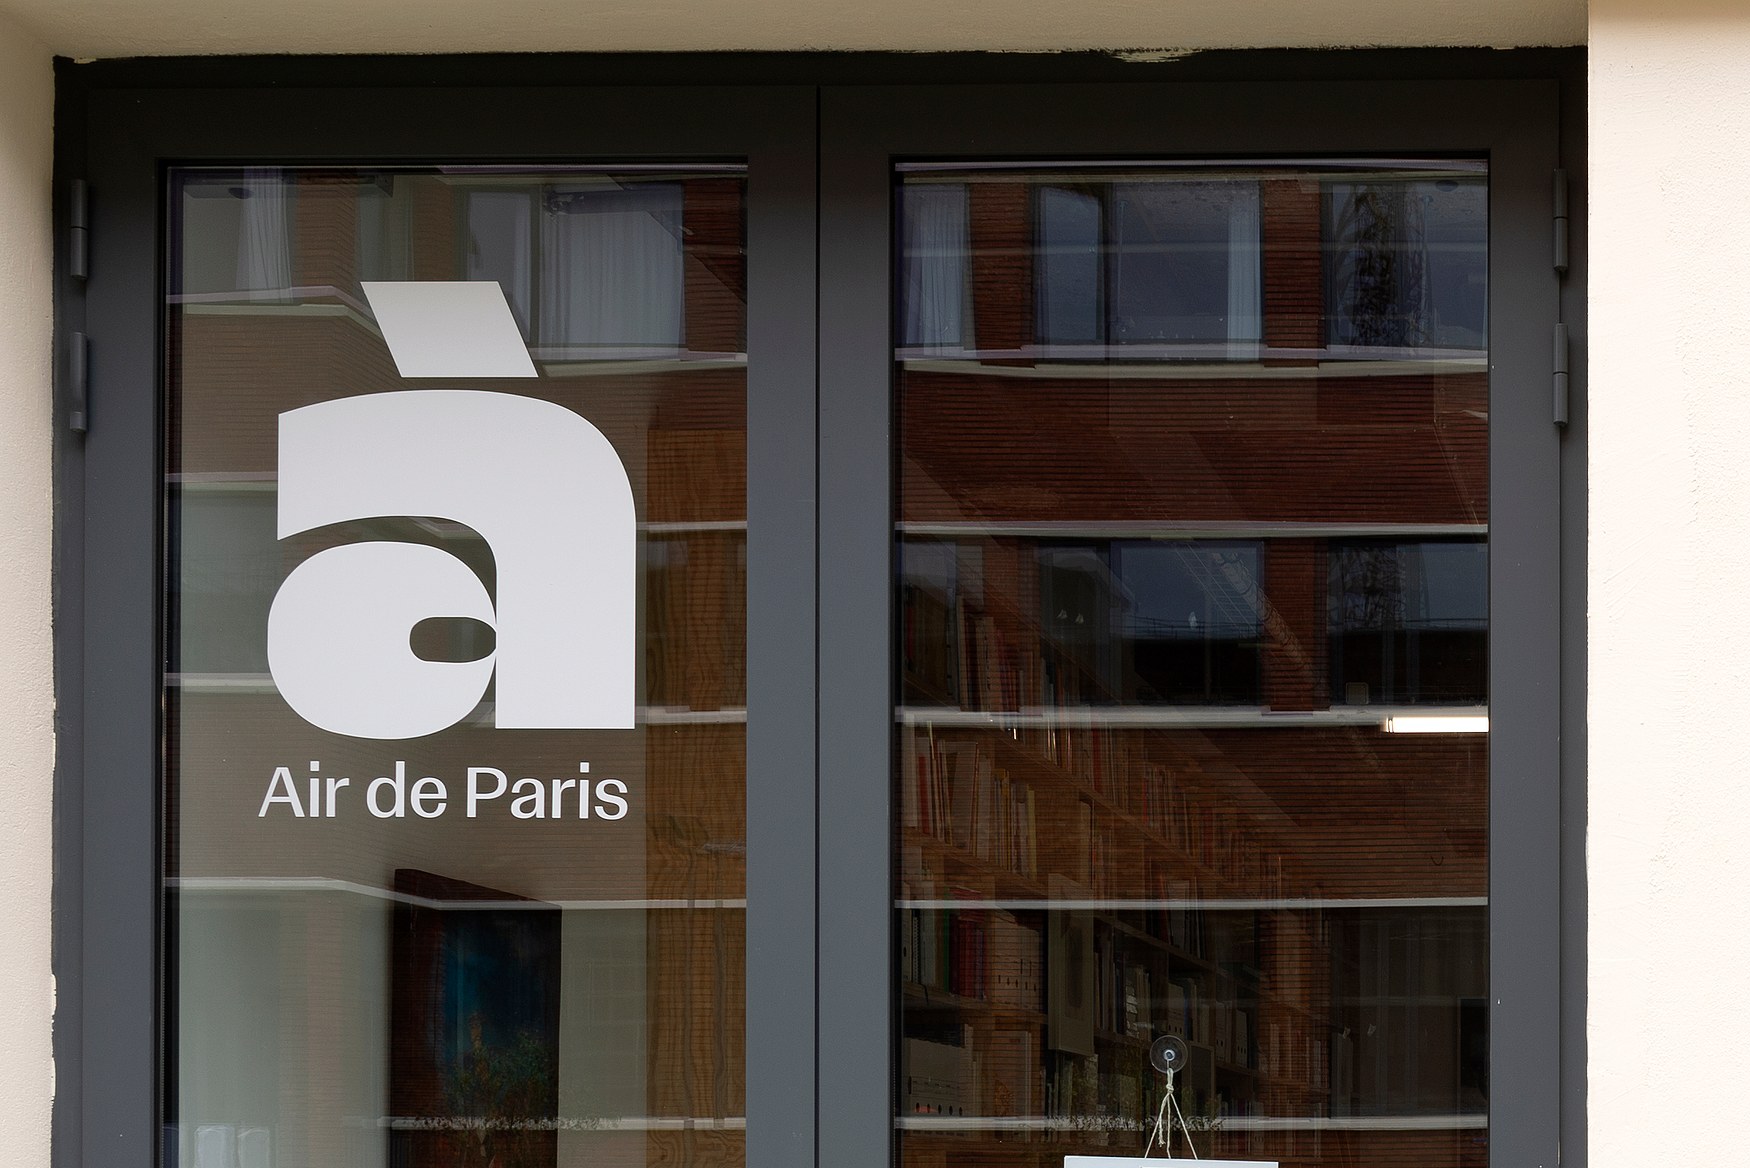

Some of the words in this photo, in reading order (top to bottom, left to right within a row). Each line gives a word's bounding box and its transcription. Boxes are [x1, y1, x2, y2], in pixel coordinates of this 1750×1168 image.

[258, 760, 350, 819] Air
[365, 760, 448, 820] de
[466, 762, 629, 821] Paris
